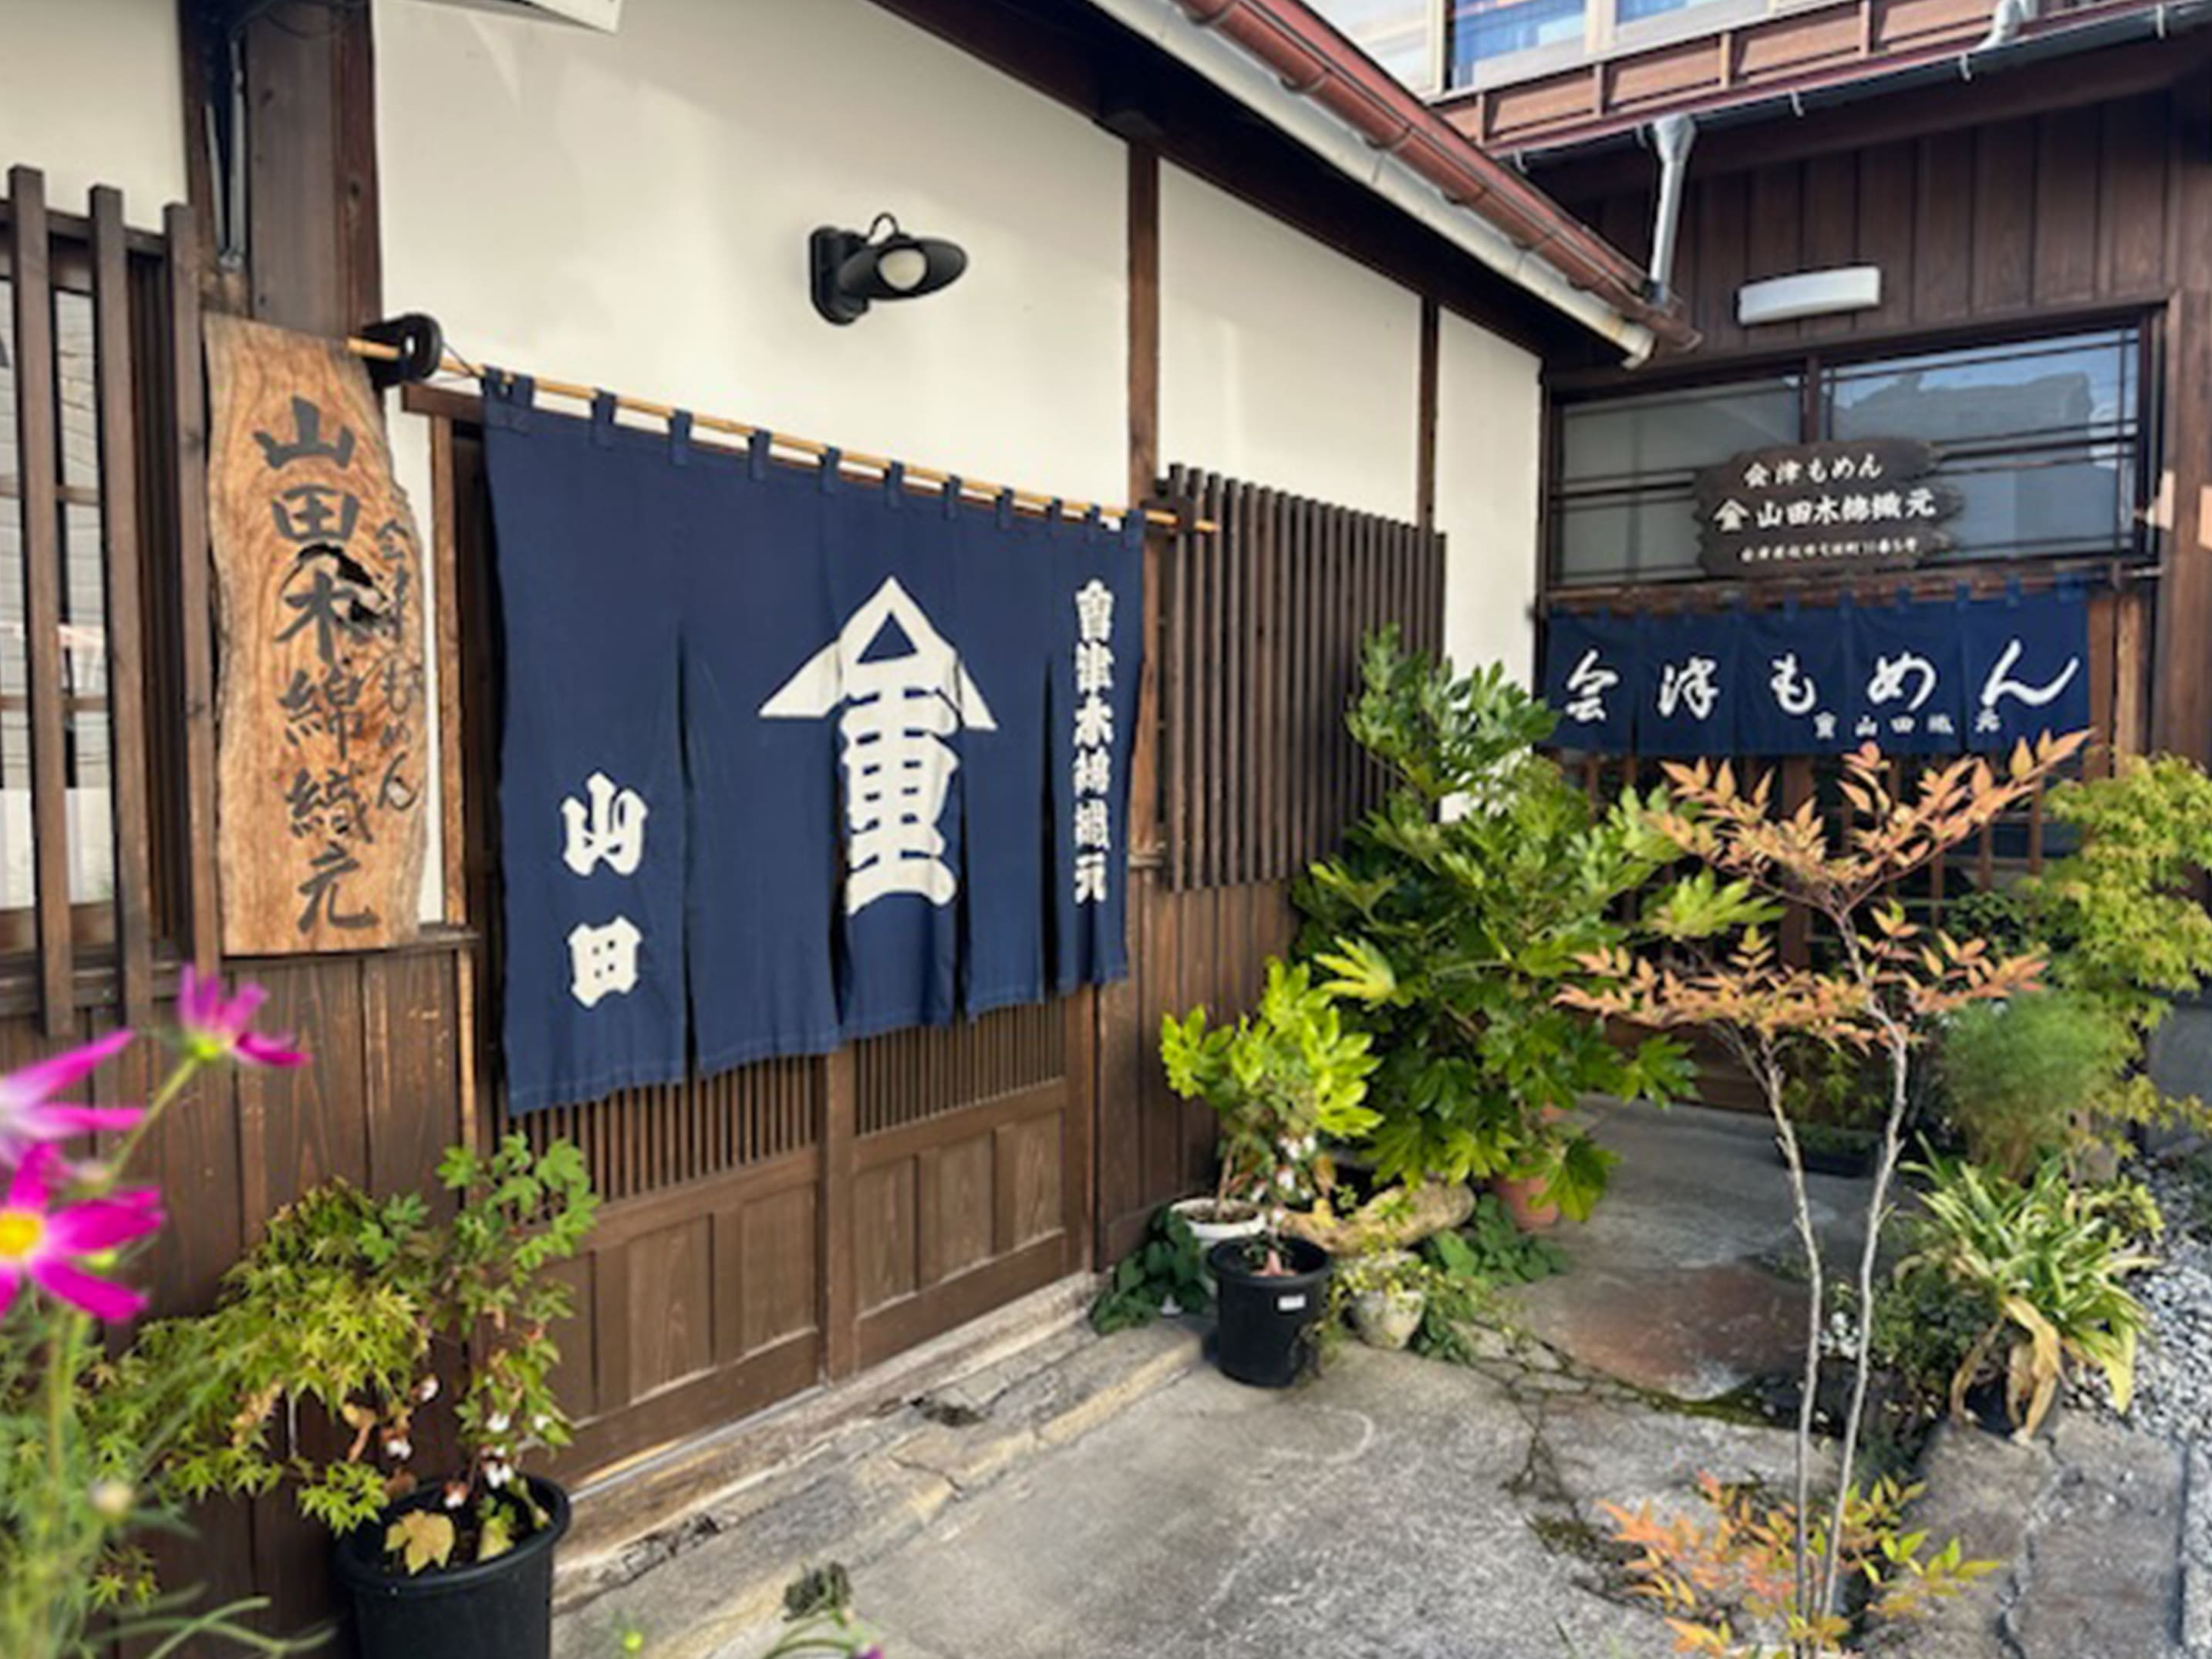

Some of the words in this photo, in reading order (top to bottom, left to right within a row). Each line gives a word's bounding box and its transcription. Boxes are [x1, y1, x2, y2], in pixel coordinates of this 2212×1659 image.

[1743, 454, 1882, 487] 会津もめん
[252, 396, 378, 930] 山田木綿織元
[1566, 639, 2079, 721] 会津もめん
[561, 771, 648, 1007] 山田
